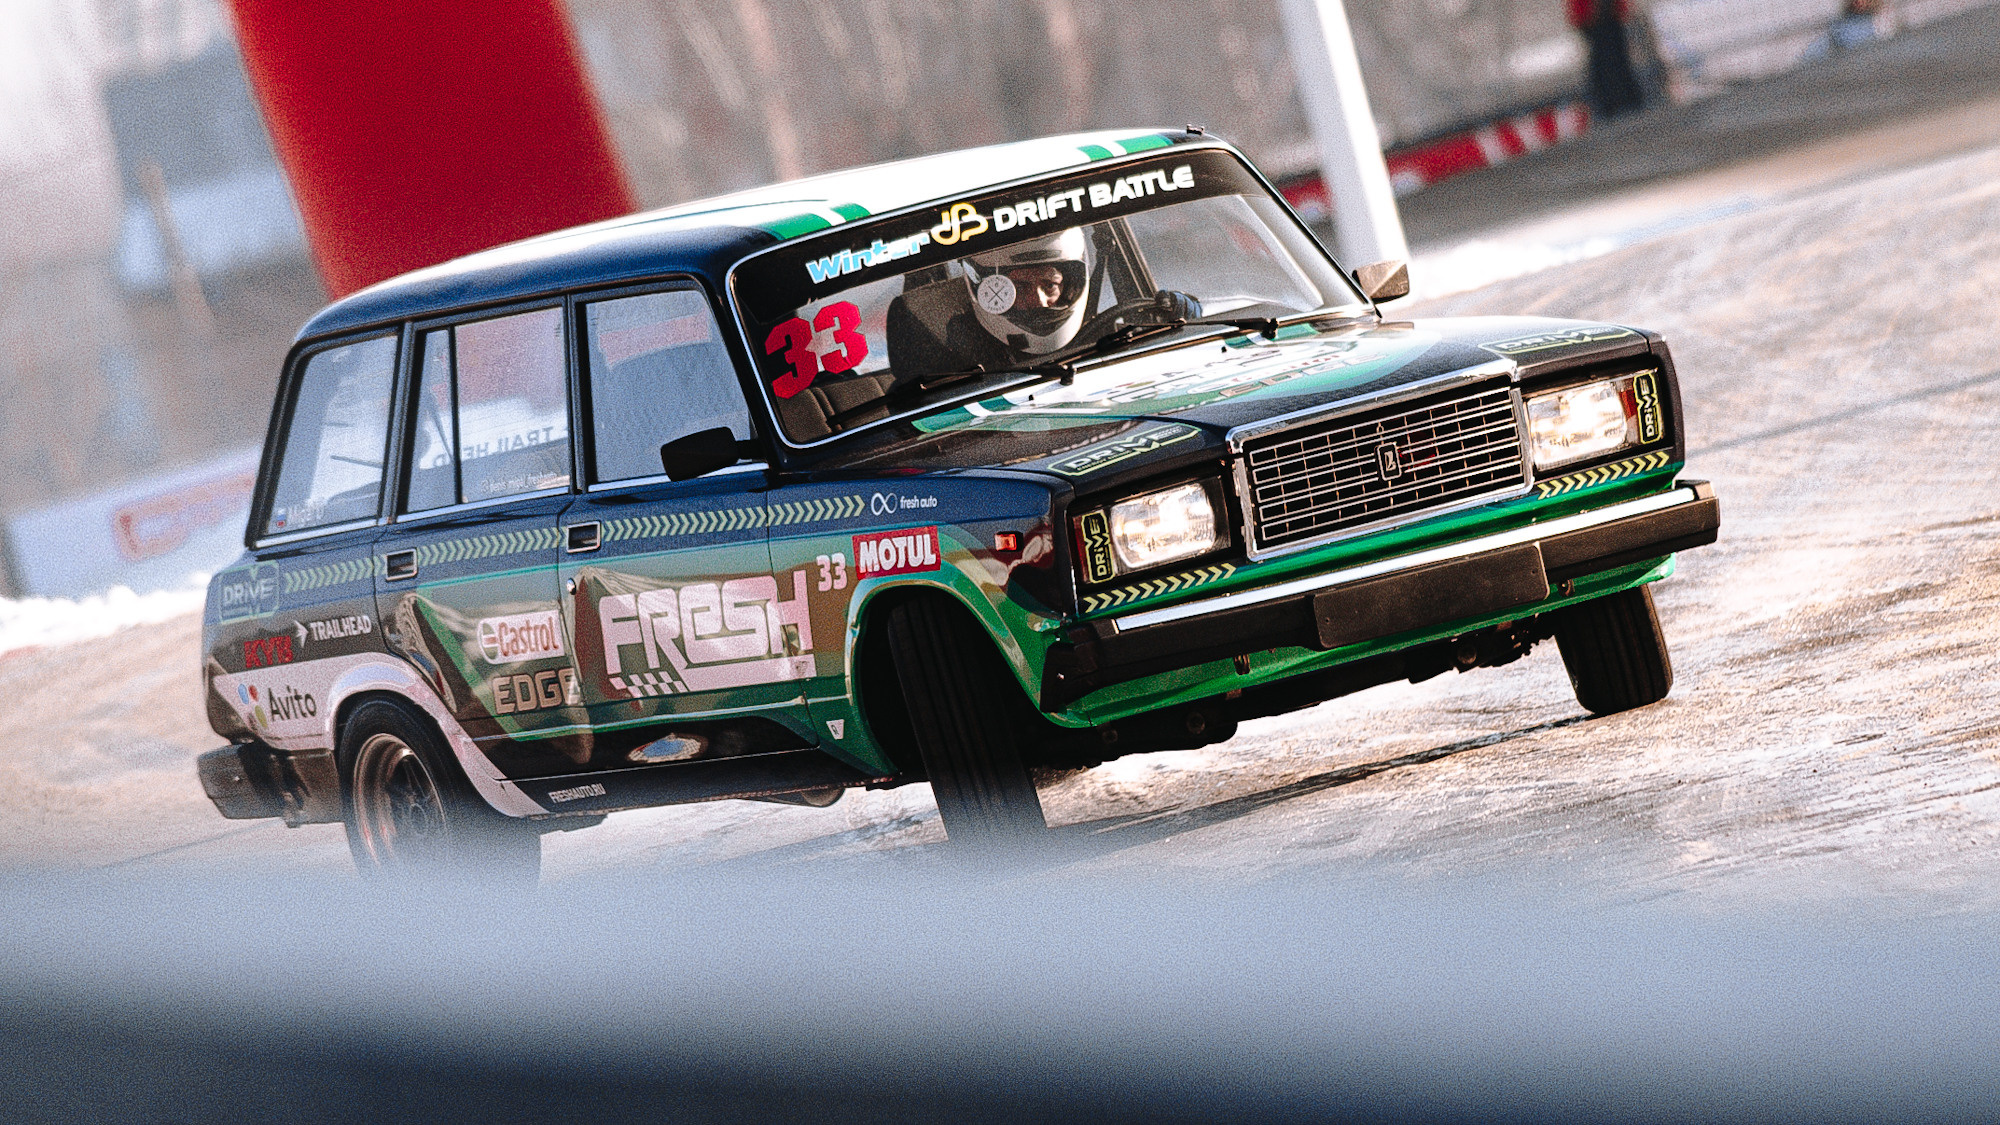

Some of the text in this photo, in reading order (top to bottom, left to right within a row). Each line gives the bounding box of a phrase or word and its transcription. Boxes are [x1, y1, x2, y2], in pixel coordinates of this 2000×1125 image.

[805, 232, 931, 284] Winter
[992, 187, 1085, 232] DRIFT
[1088, 164, 1195, 208] BATTLE
[764, 300, 869, 399] 33
[900, 495, 938, 509] fresh auto
[816, 552, 848, 592] 33
[859, 533, 937, 574] MOTUL
[310, 615, 372, 641] TRAILHEAD
[498, 616, 560, 657] Castrol
[243, 634, 294, 669] KYB
[267, 684, 317, 721] Avito
[493, 667, 580, 715] EDGE
